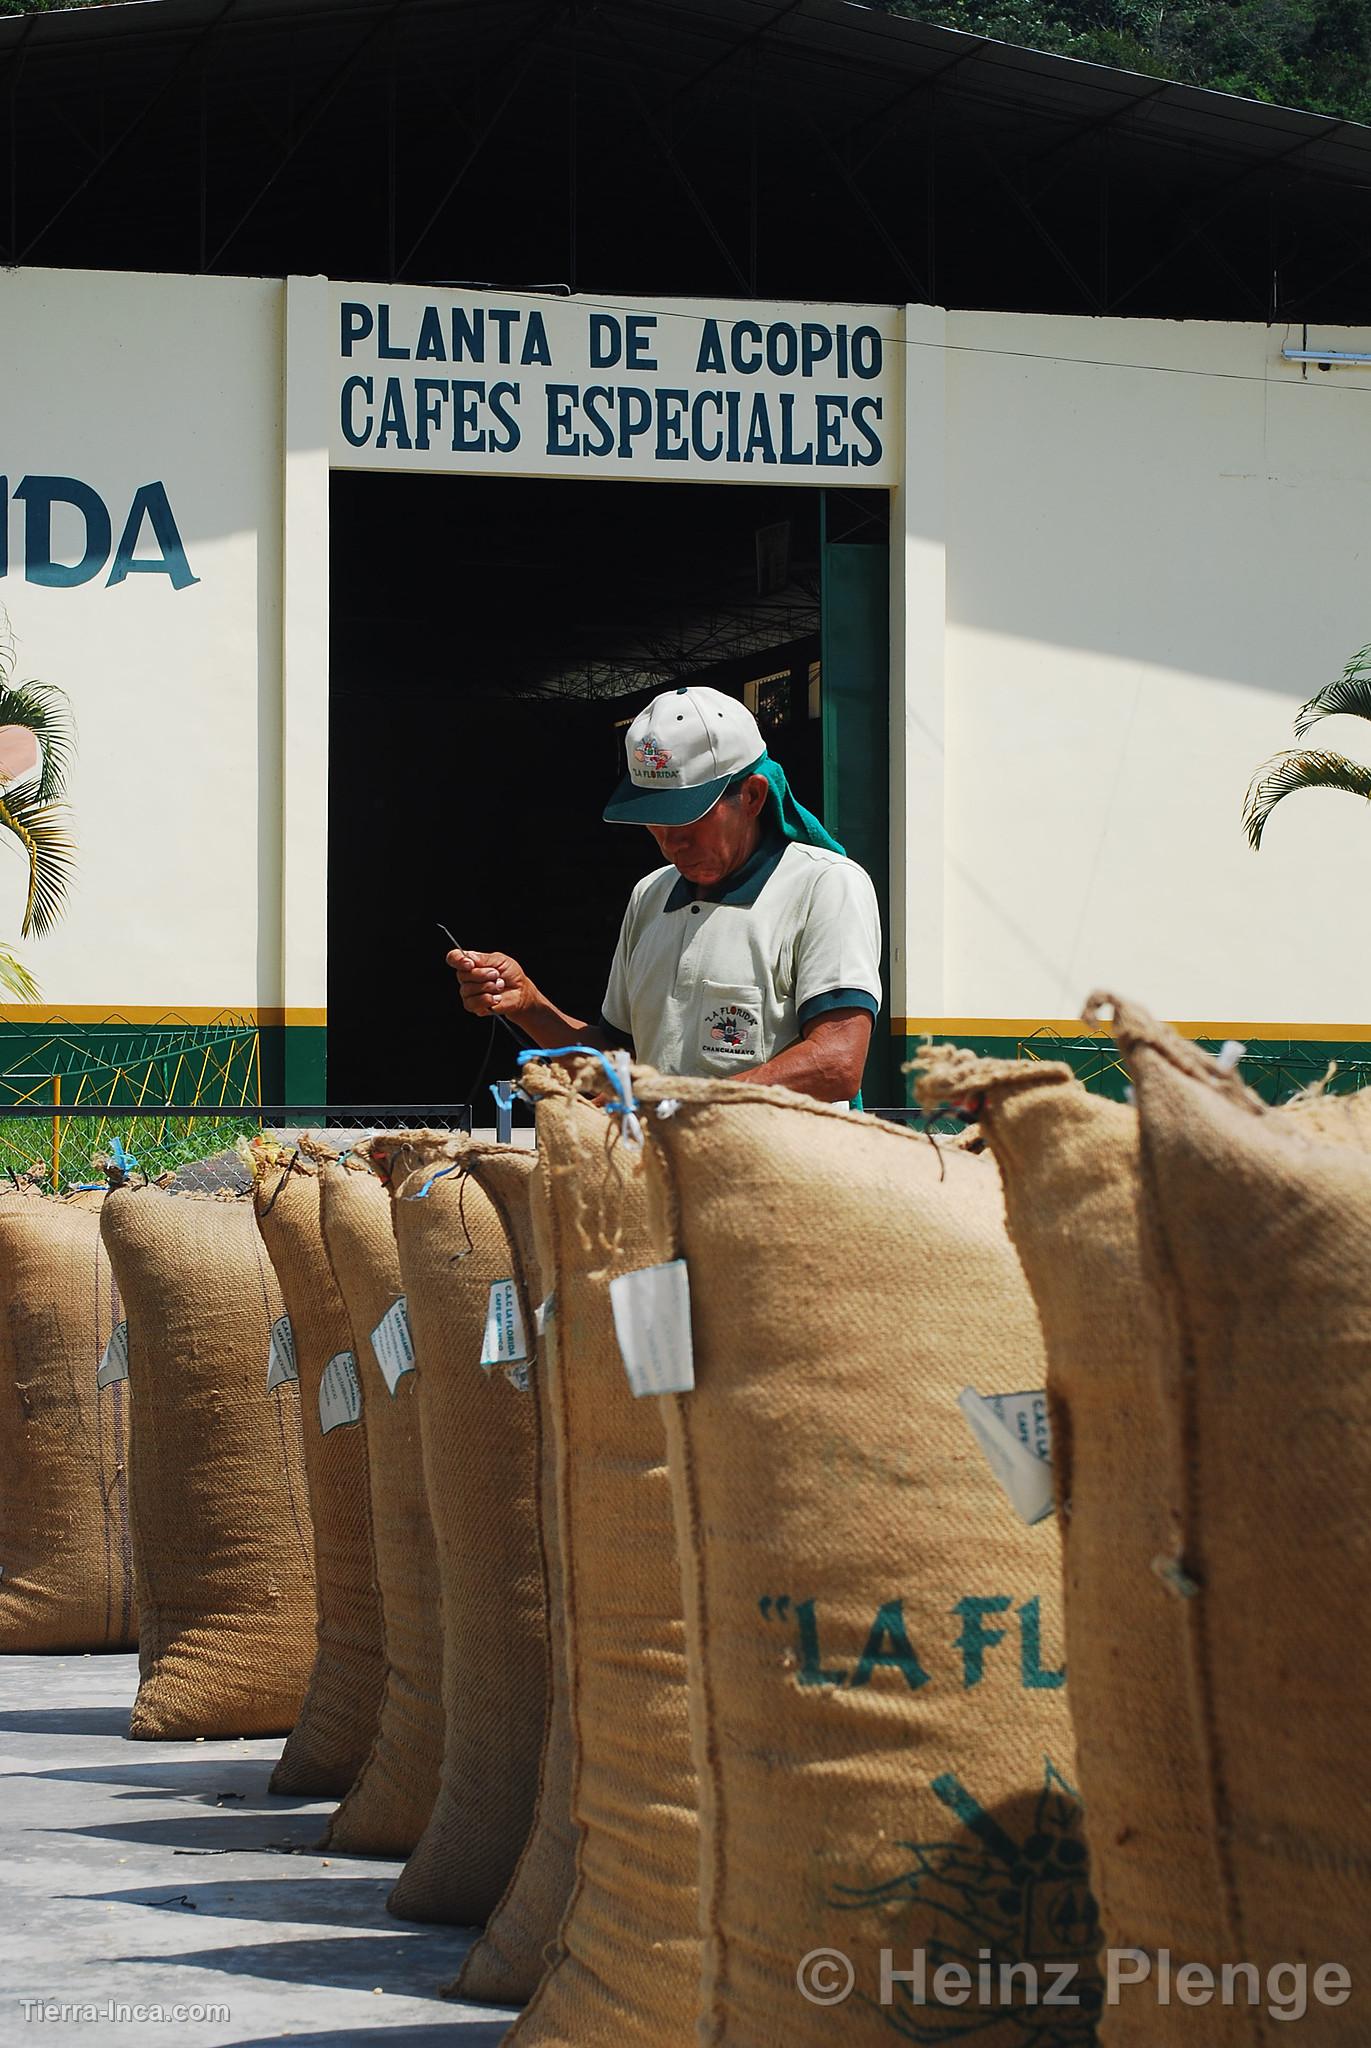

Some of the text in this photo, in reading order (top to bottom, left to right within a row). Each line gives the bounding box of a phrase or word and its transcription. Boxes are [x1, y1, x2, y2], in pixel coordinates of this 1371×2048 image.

[340, 302, 883, 380] PLANTA DE ACOPIO
[340, 375, 883, 467] CAFES ESPECIALES
[702, 1045, 756, 1056] CHANCHAMAYO
[505, 1308, 513, 1319] LA
[506, 1320, 516, 1357] FLORIDA
